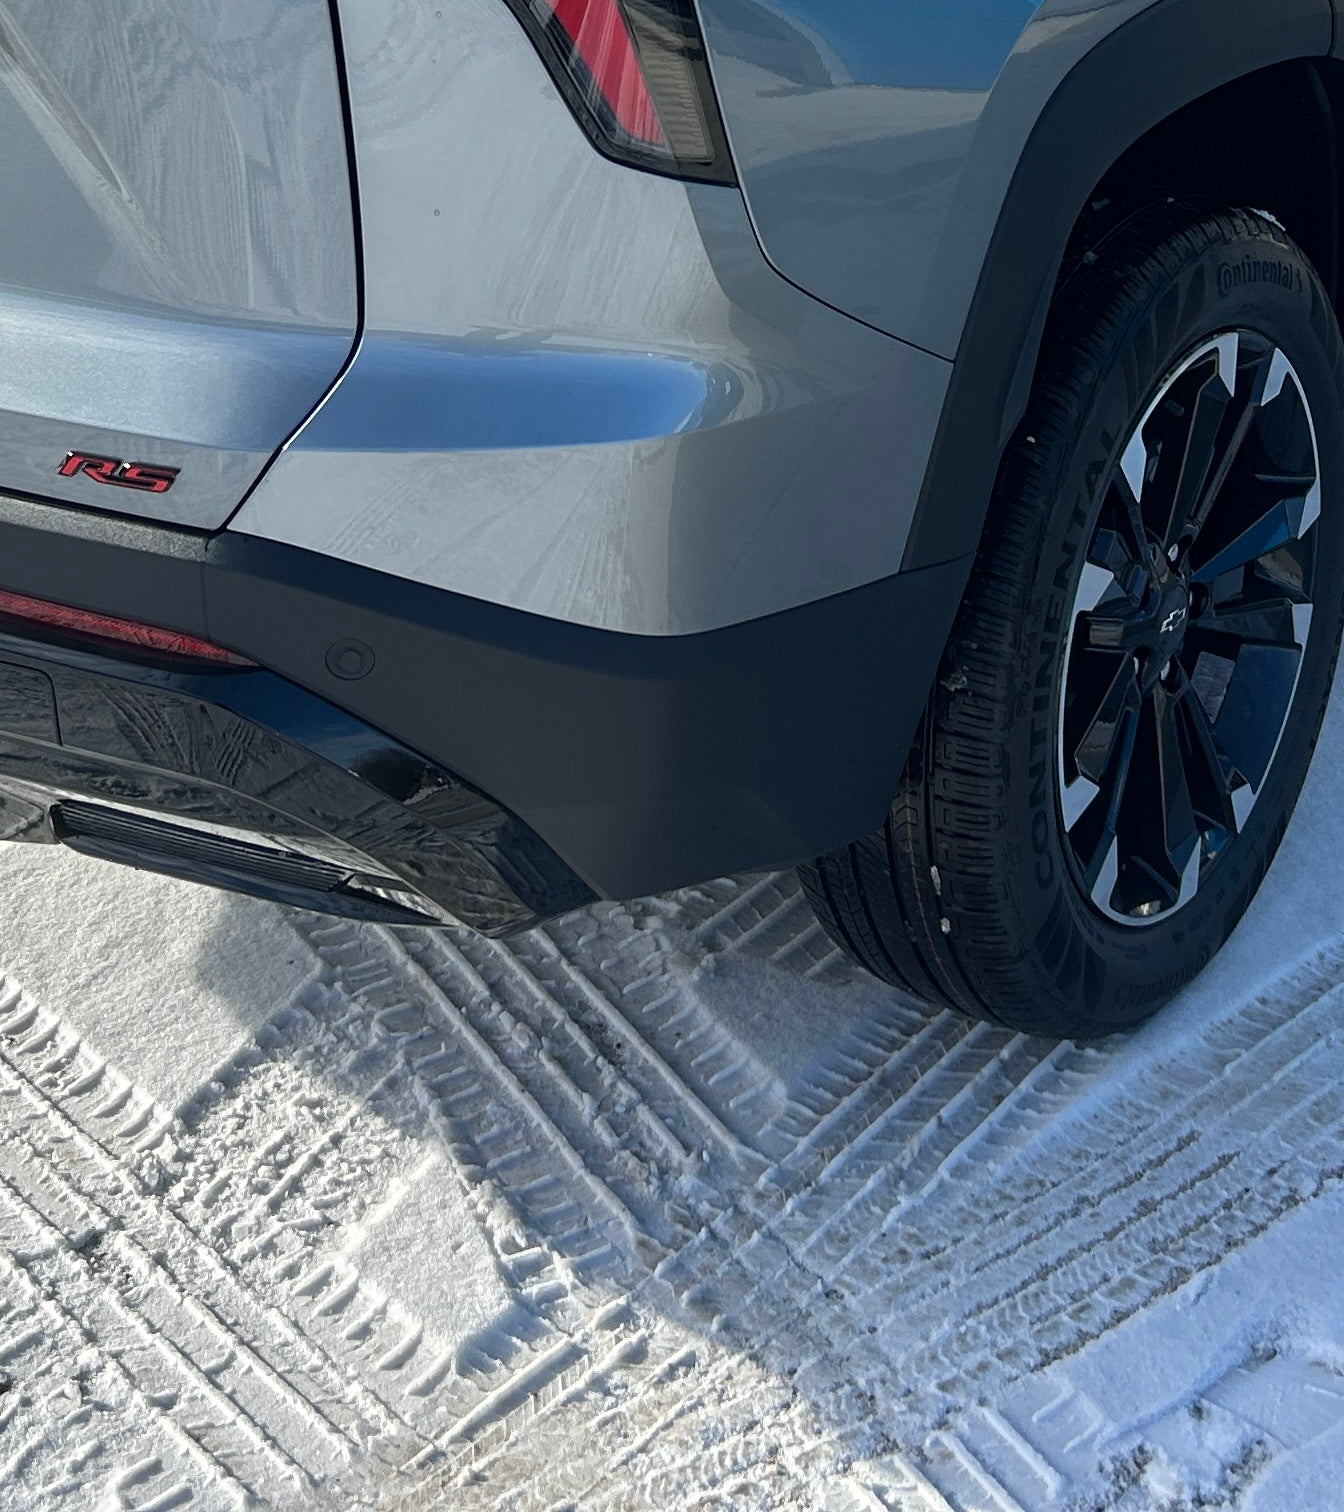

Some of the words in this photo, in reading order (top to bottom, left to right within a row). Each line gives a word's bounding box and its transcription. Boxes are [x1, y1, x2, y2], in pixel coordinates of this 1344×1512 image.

[1216, 253, 1294, 298] Continental
[58, 450, 182, 494] RS
[1026, 425, 1123, 894] CONTINENTAL
